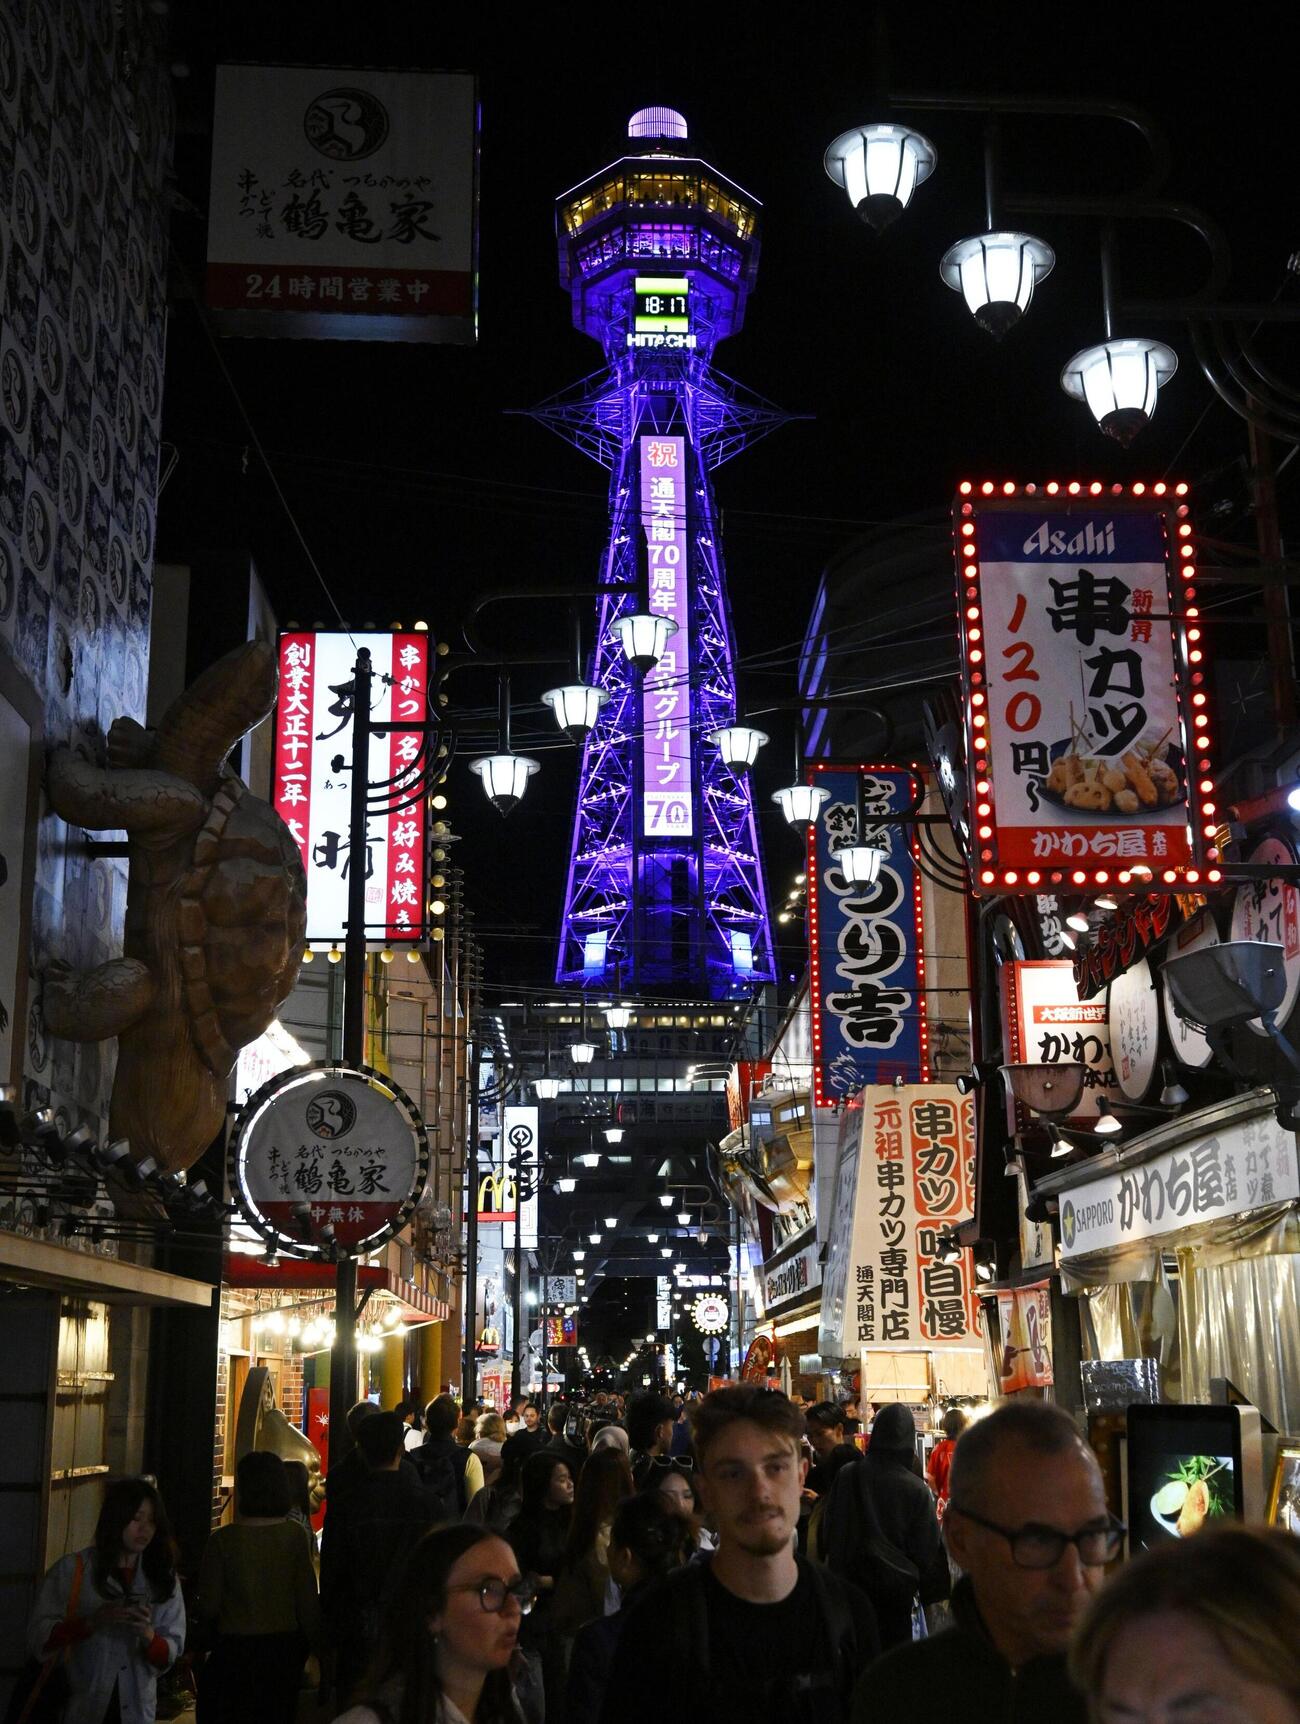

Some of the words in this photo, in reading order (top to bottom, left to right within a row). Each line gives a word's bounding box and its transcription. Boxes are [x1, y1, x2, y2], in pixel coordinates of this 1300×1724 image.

[282, 168, 333, 189] 名代
[280, 189, 442, 243] 鶴亀家
[245, 273, 431, 303] 24時間営業中
[645, 296, 686, 315] 18:17
[626, 332, 697, 348] HITACHI
[646, 441, 678, 467] 祝
[647, 475, 681, 618] 通天閣70周年
[1022, 520, 1117, 557] Asahi
[398, 643, 422, 717] 串かつ
[1045, 568, 1149, 757] 串カツ
[279, 641, 311, 807] 創業大正十二年
[652, 651, 681, 785] 日立グループ
[646, 800, 689, 829] 70
[1032, 829, 1149, 858] かわち屋
[1151, 830, 1168, 856] 本店
[1037, 1031, 1114, 1064] かわ
[294, 1158, 391, 1196] 鶴亀家
[913, 1103, 957, 1214] 串カツ
[1117, 1136, 1226, 1232] かわち屋
[1224, 1153, 1238, 1202] 本店
[309, 1205, 367, 1224] 中無休
[873, 1100, 910, 1341] 元祖串カツ専門店
[1076, 1199, 1115, 1234] SAPPORO
[855, 1265, 875, 1342] 通天閣店
